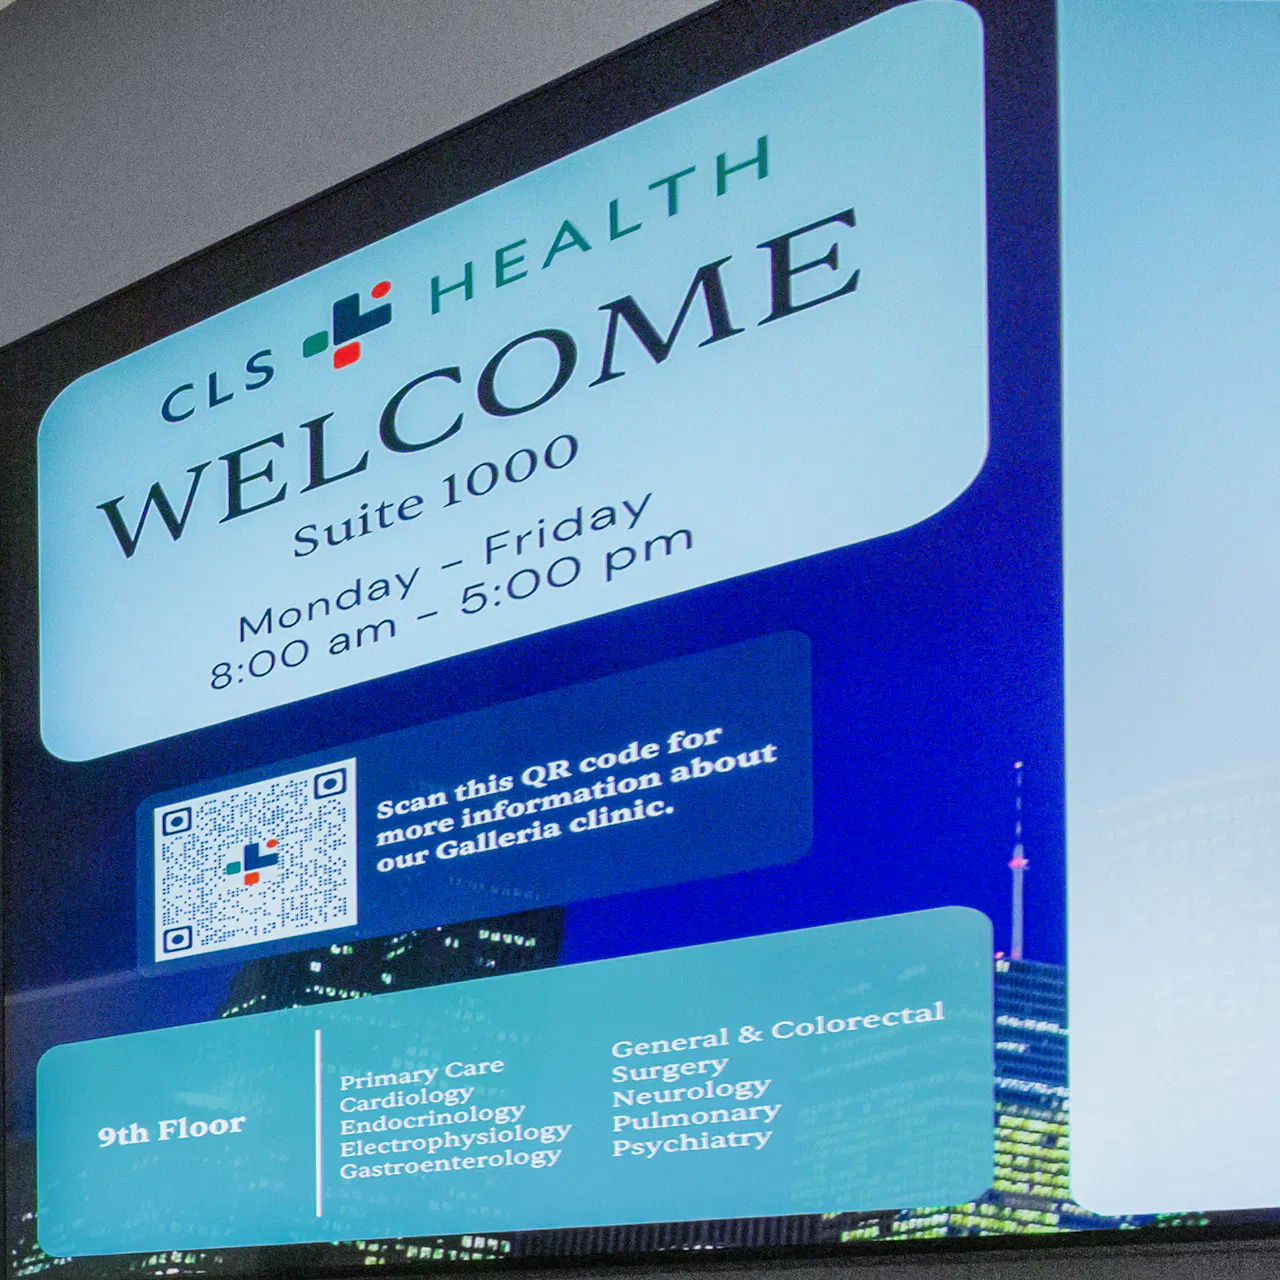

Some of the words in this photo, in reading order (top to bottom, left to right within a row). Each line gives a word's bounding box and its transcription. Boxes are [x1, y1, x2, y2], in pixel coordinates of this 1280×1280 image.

[160, 348, 277, 423] CLS
[429, 134, 771, 315] HEALTH
[96, 208, 861, 559] WELCOME
[292, 479, 424, 559] Suite
[442, 432, 580, 510] 1000
[239, 564, 422, 643] Monday
[485, 489, 656, 567] Friday
[209, 640, 310, 692] 8:00
[327, 618, 397, 658] am
[461, 557, 582, 616] 5:00
[605, 523, 694, 582] pm
[377, 792, 448, 819] Scan
[455, 773, 514, 802] this
[522, 759, 571, 790] QR
[578, 742, 660, 773] code
[667, 726, 723, 754] for
[376, 818, 455, 847] more
[462, 771, 663, 829] information
[670, 743, 778, 783] about
[376, 849, 430, 873] our
[436, 819, 562, 860] Galleria
[570, 799, 675, 832] clinic.
[611, 1028, 729, 1058] General
[738, 1025, 764, 1044] &
[772, 1001, 945, 1040] Colorectal
[339, 1066, 438, 1092] Primary
[445, 1056, 505, 1079] Care
[612, 1057, 729, 1084] Surgery
[339, 1083, 475, 1114] Cardiology
[612, 1077, 772, 1108] Neurology
[97, 1121, 150, 1148] 9th
[158, 1110, 247, 1142] Floor
[339, 1102, 526, 1136] Endocrinology
[612, 1104, 781, 1132] Pulmonary
[339, 1121, 573, 1159] Electrophysiology
[612, 1131, 773, 1160] Psychiatry
[339, 1146, 563, 1179] Gastroenterology
